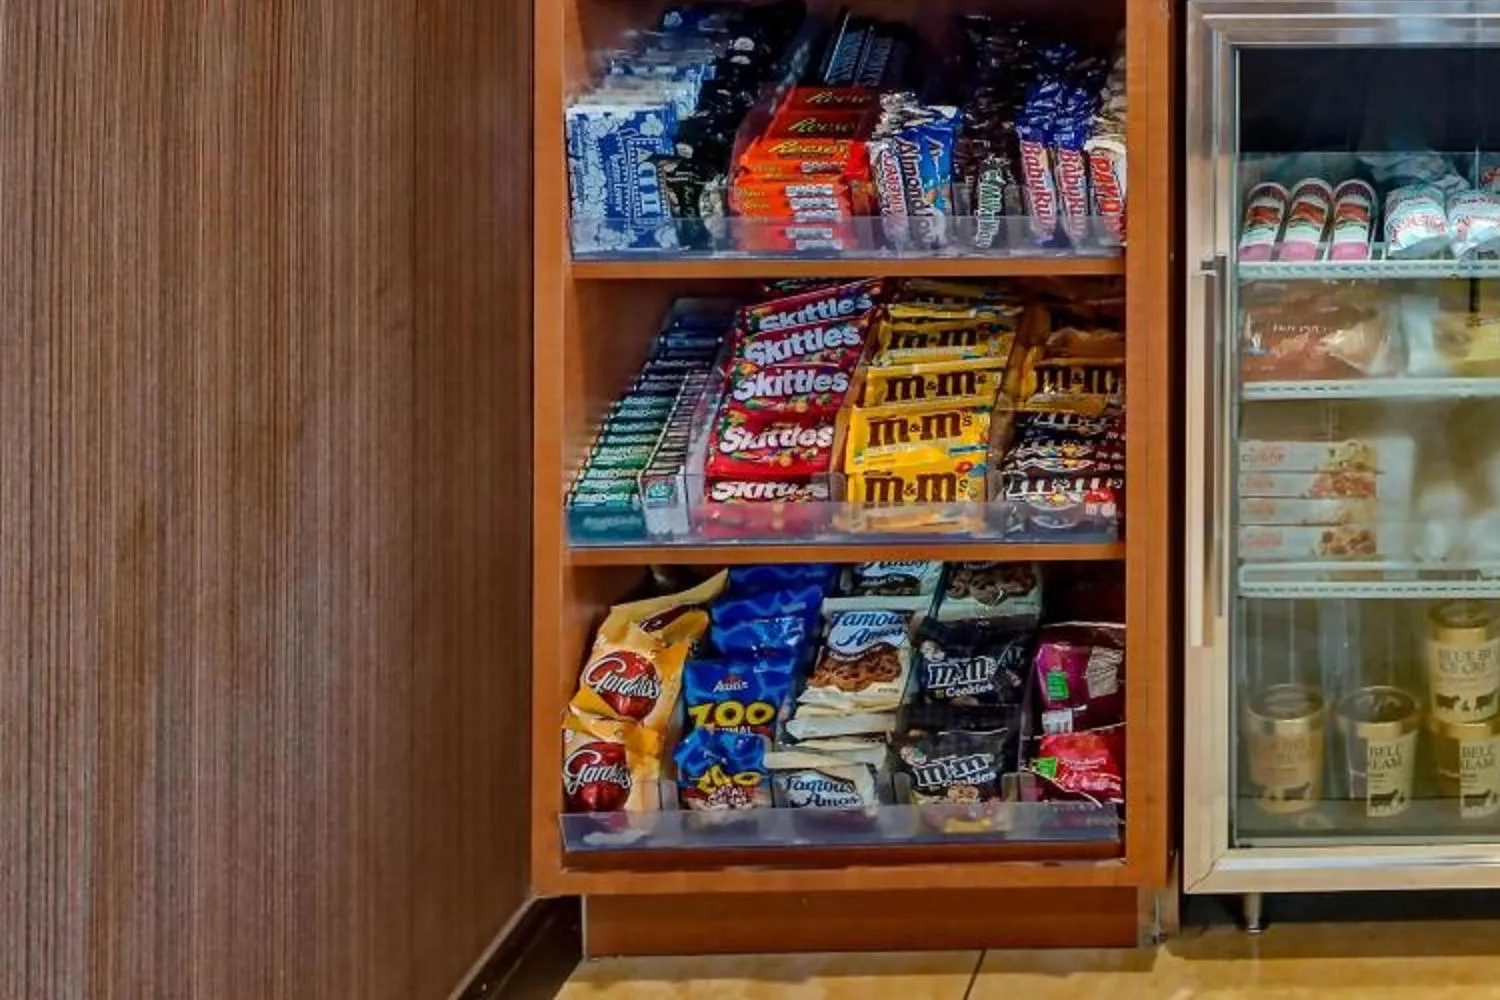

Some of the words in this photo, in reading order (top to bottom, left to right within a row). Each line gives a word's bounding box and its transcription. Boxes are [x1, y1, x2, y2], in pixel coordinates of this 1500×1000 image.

[895, 138, 928, 209] Almond
[759, 293, 873, 330] Skittles
[744, 323, 861, 365] Skittles
[733, 369, 850, 401] Skittles
[719, 421, 834, 452] Skittles
[945, 683, 995, 698] Cookies
[784, 778, 857, 794] Famous
